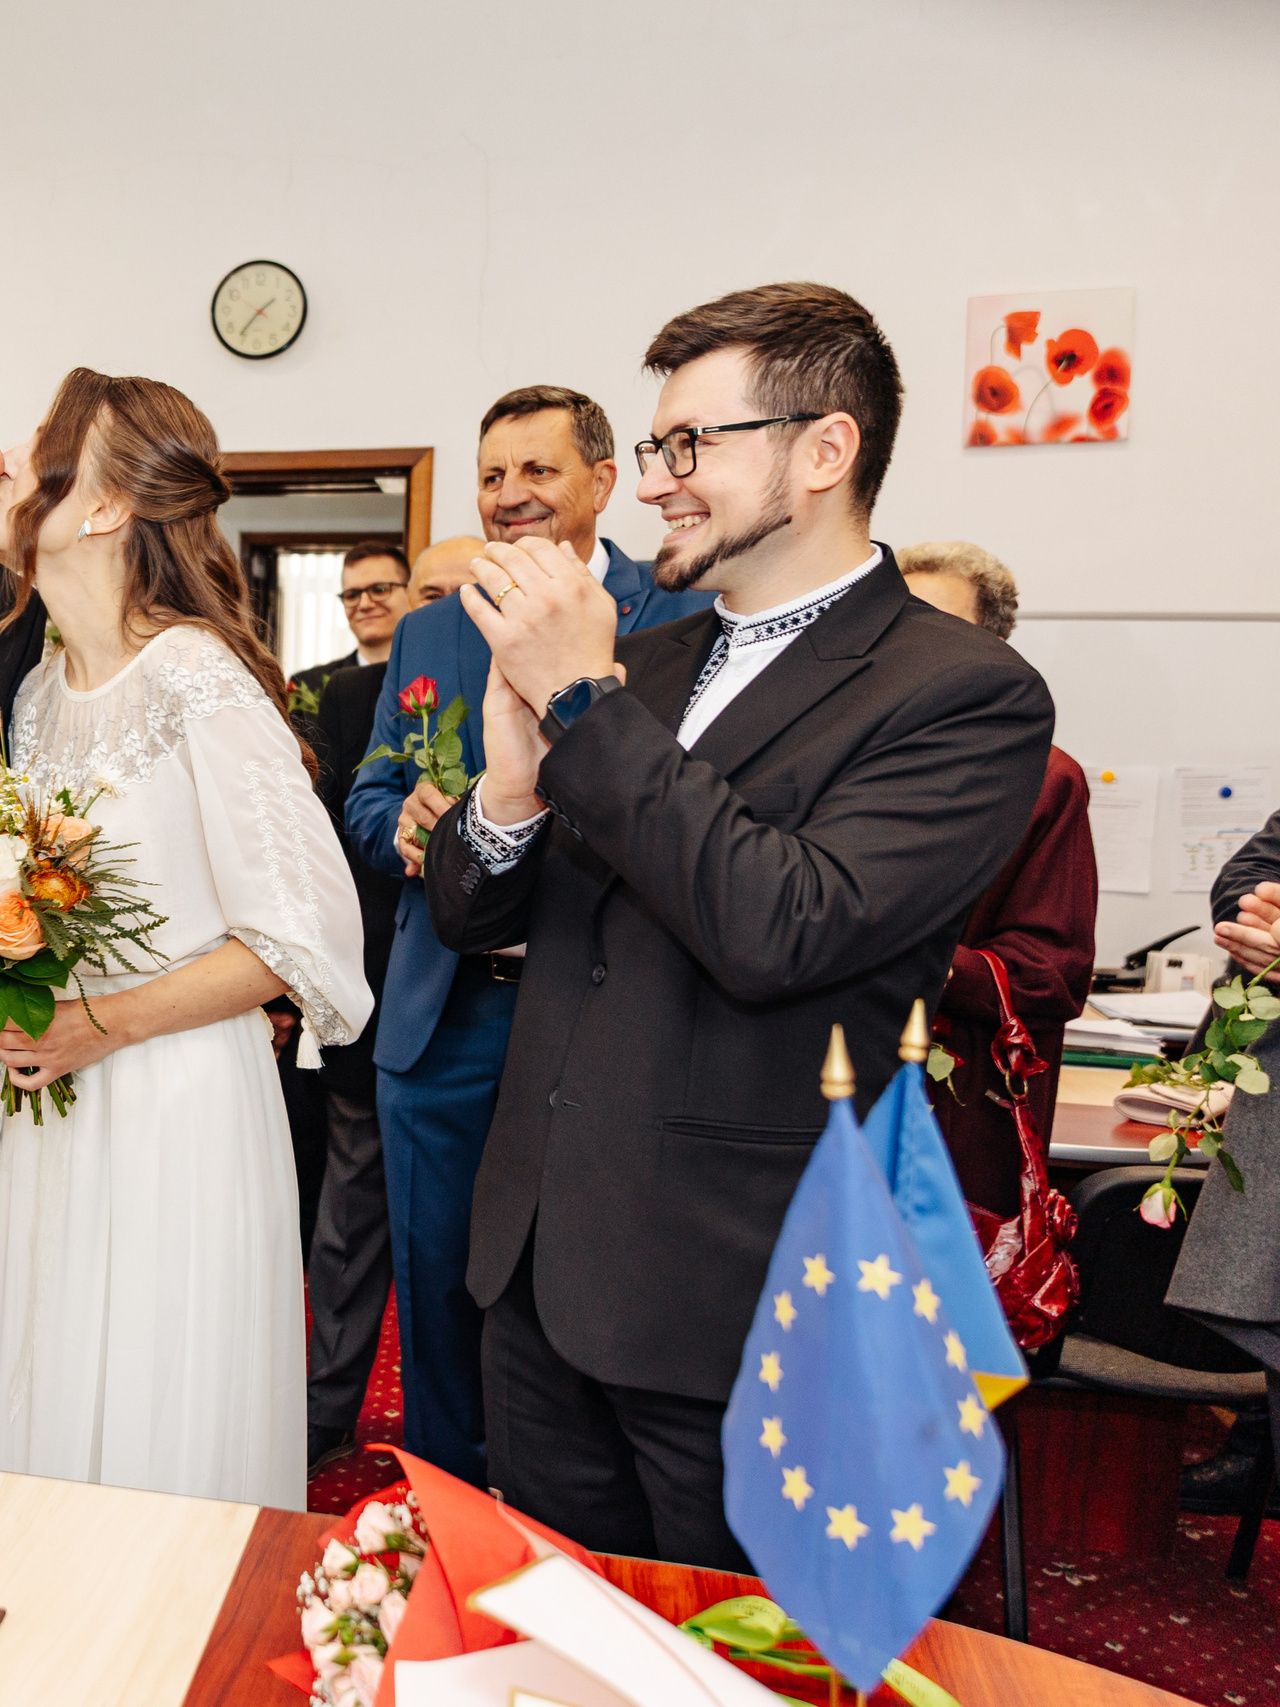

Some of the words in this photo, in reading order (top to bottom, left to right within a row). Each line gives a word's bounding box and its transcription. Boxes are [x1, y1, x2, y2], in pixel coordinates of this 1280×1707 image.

[255, 272, 267, 286] 12
[229, 289, 239, 302] 10
[285, 290, 293, 302] 2
[289, 305, 297, 318] 3
[226, 322, 234, 334] 8
[282, 322, 291, 332] 4
[252, 338, 261, 350] 6
[269, 333, 278, 346] 5
